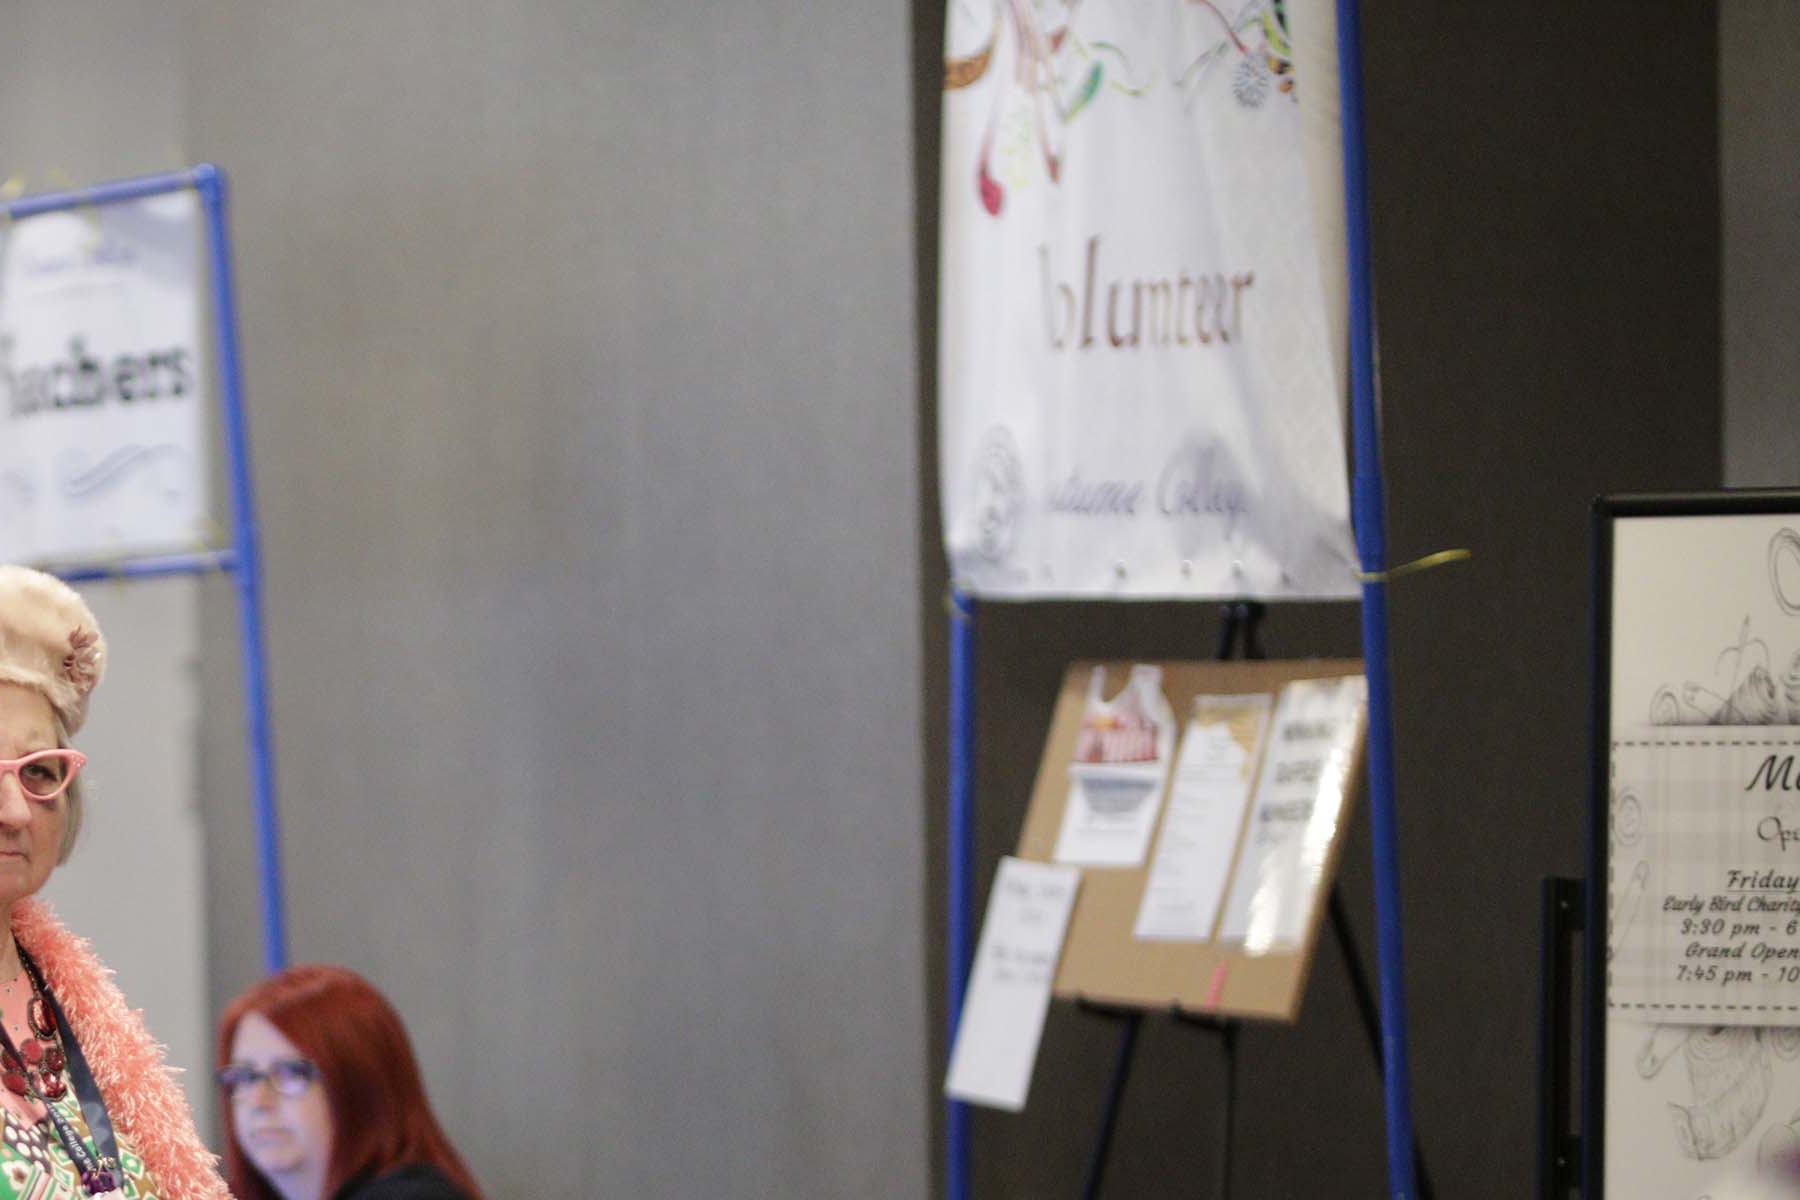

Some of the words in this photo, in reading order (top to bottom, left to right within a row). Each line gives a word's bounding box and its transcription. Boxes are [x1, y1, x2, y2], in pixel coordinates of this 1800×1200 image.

[1726, 868, 1800, 896] Friday
[1661, 895, 1705, 917] Early
[1708, 895, 1747, 913] Bird
[1680, 917, 1726, 936] 3:30
[1728, 923, 1761, 941] pm
[1684, 940, 1748, 960] Grand
[1750, 940, 1800, 965] Open
[1676, 963, 1720, 983] 7:45
[1720, 969, 1753, 988] pm
